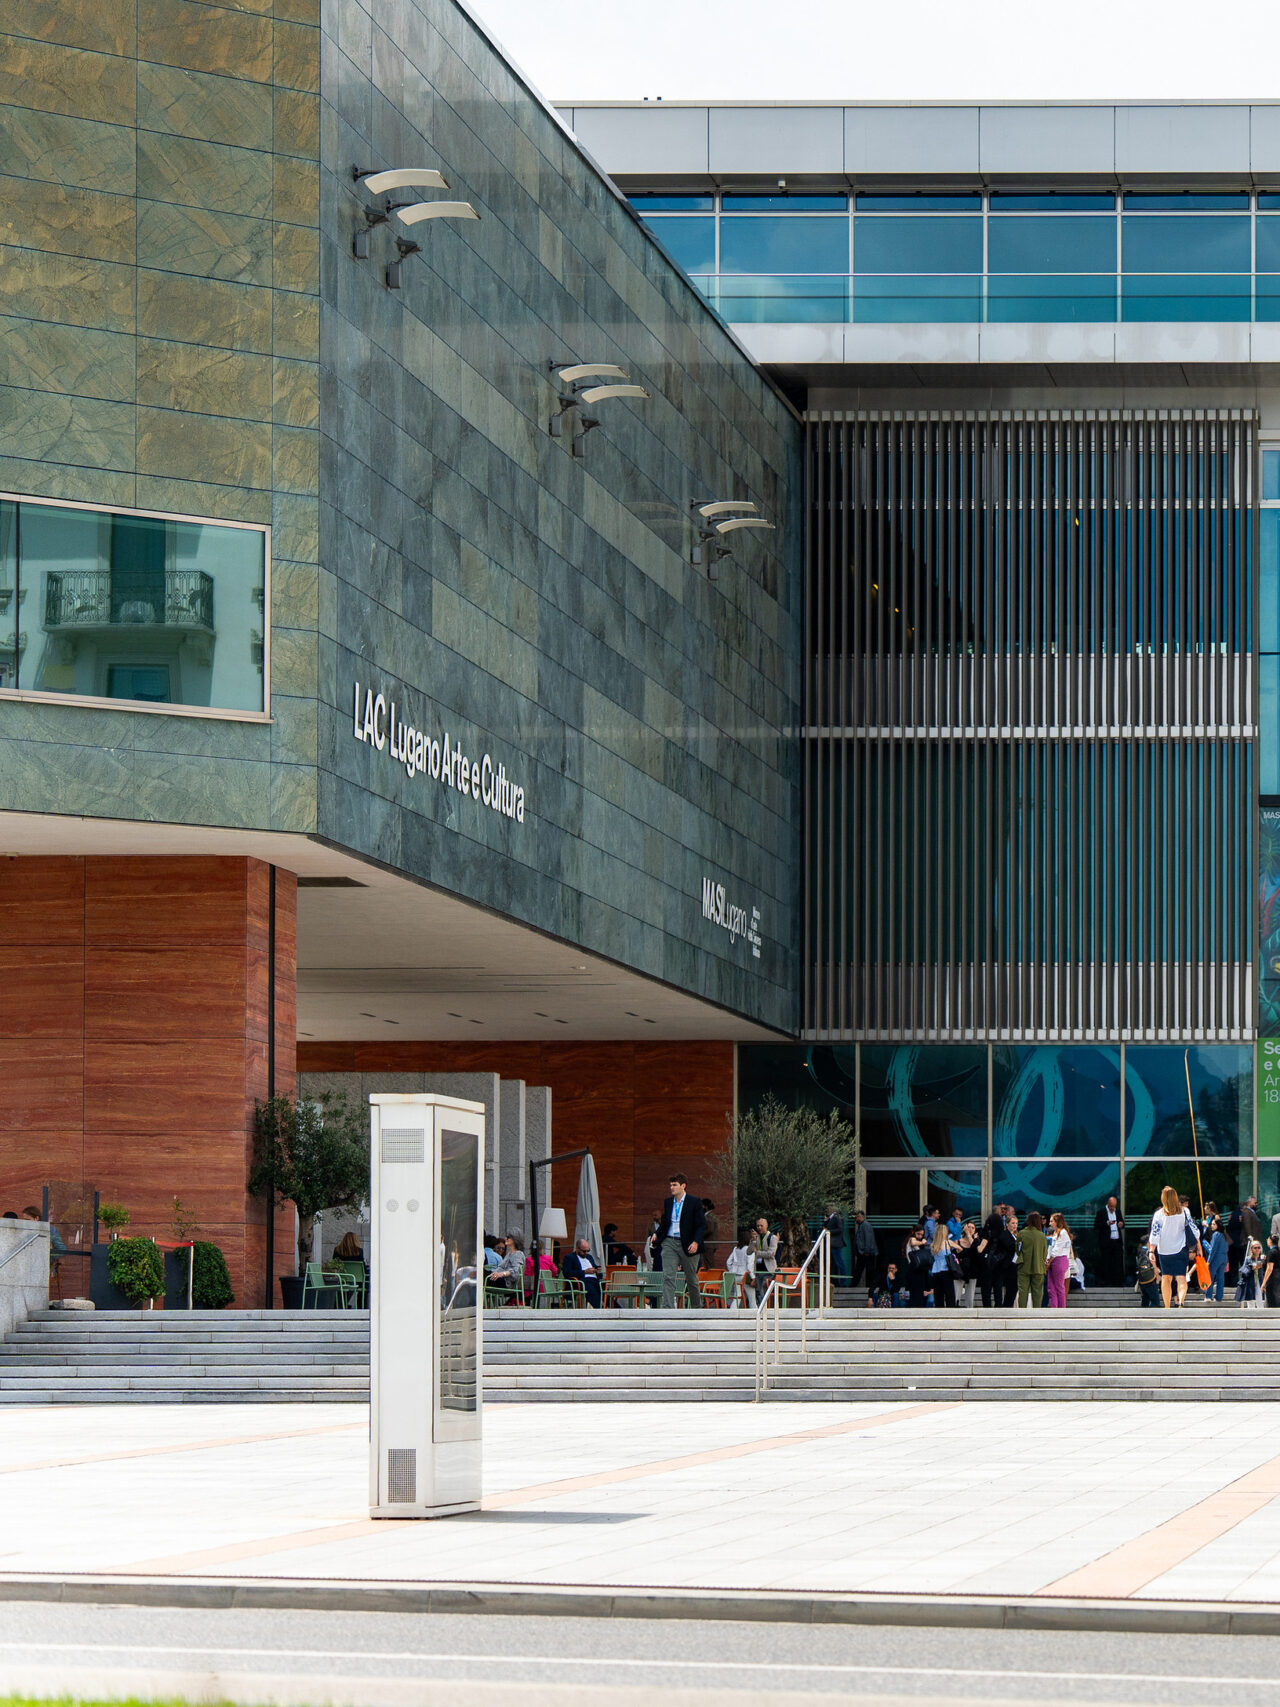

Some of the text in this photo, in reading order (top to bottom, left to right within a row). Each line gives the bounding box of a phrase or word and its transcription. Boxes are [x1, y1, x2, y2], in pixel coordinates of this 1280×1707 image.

[354, 682, 524, 823] LAC Lugano Arte e Cultura
[1264, 1061, 1273, 1071] e
